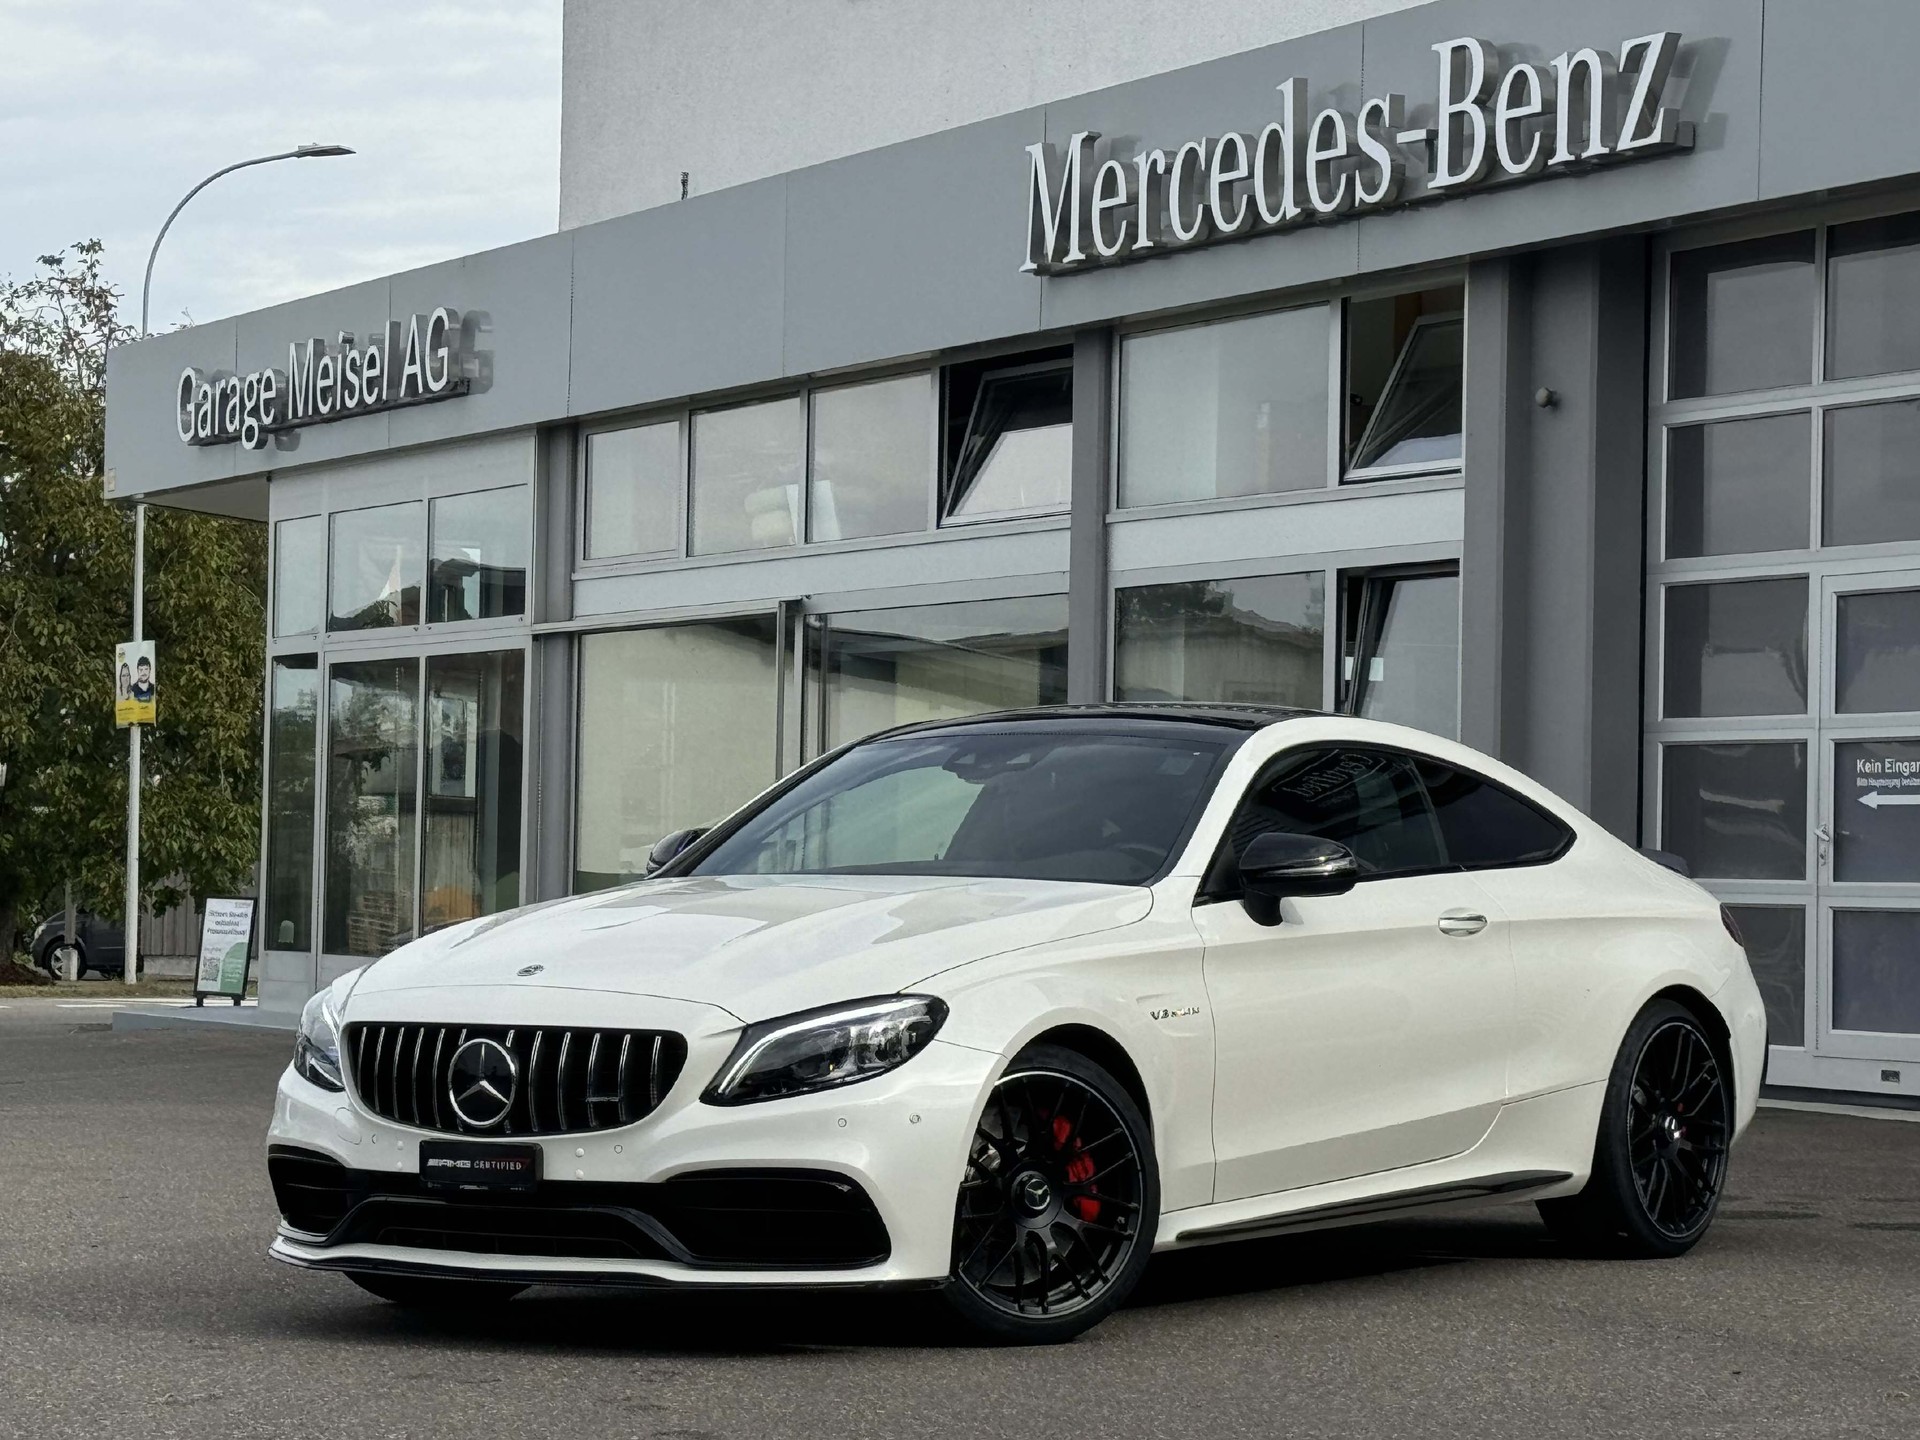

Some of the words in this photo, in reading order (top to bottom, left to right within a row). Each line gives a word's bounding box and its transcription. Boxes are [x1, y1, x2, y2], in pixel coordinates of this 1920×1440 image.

[1019, 31, 1678, 273] Mercedes-Benz
[177, 367, 278, 450] Garage
[288, 320, 392, 420] Meisel
[400, 307, 451, 398] AG
[1856, 758, 1882, 774] Kein
[1884, 758, 1920, 777] Einga
[473, 1160, 522, 1171] CERTIFIED
